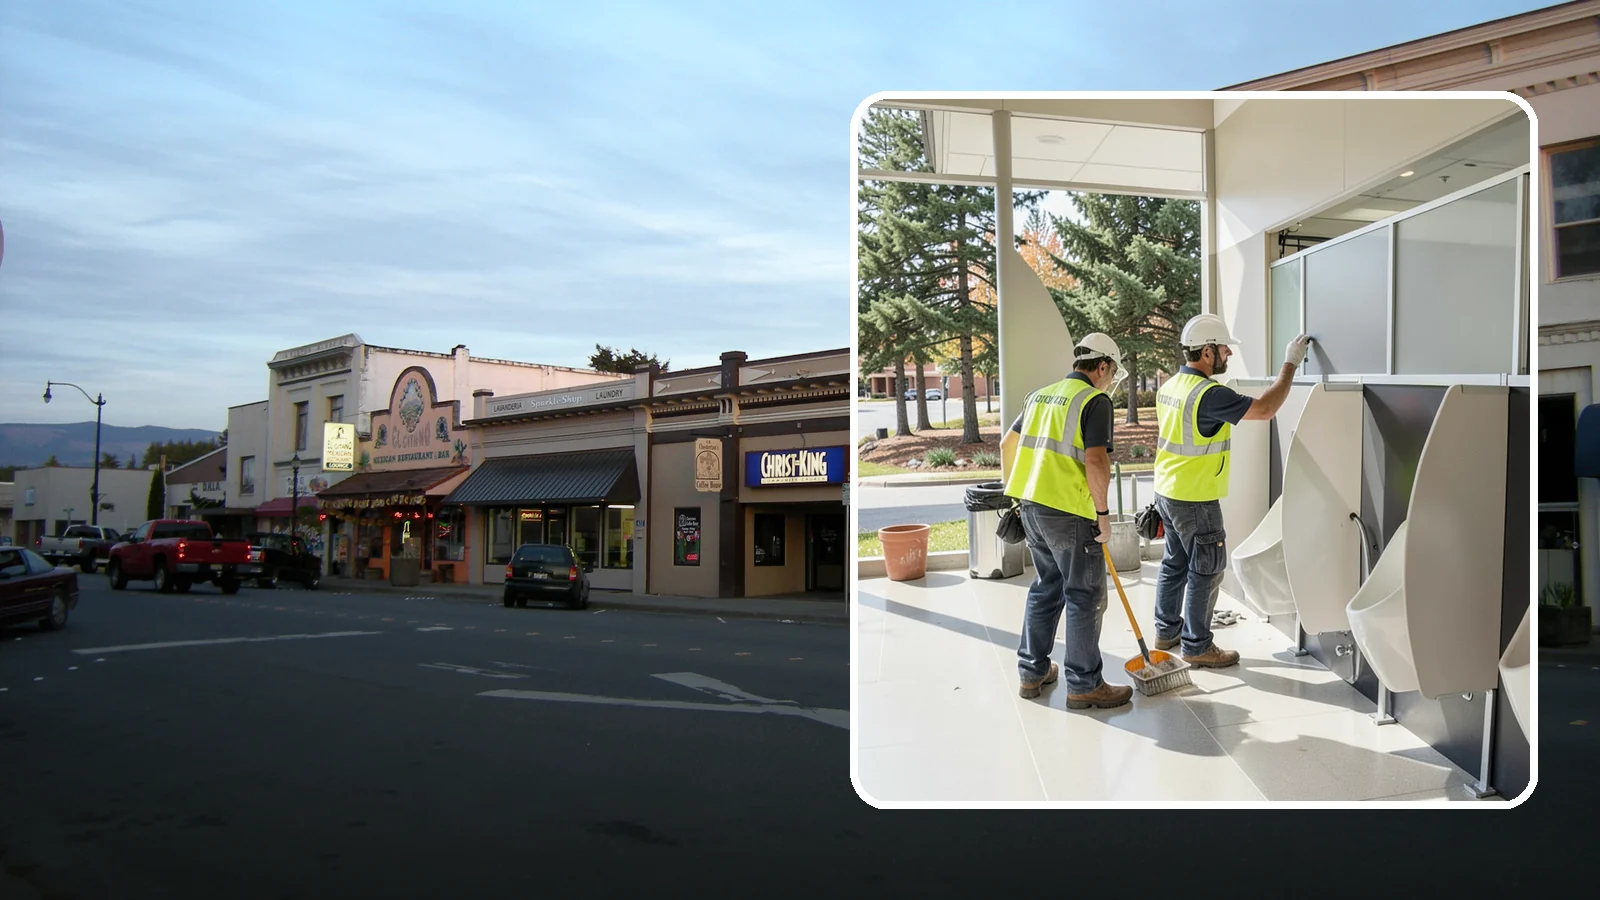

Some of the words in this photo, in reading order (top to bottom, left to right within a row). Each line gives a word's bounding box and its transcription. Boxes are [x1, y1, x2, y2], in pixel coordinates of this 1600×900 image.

[595, 389, 624, 399] LAUNDRY
[494, 402, 523, 412] LAVANDERIA
[530, 397, 561, 408] Sparkle
[562, 395, 582, 405] Shop
[373, 455, 396, 464] MEXICAN
[397, 451, 433, 462] RESTAURANT
[438, 450, 450, 459] BAR
[761, 452, 796, 477] CHRIST
[799, 450, 828, 476] KING
